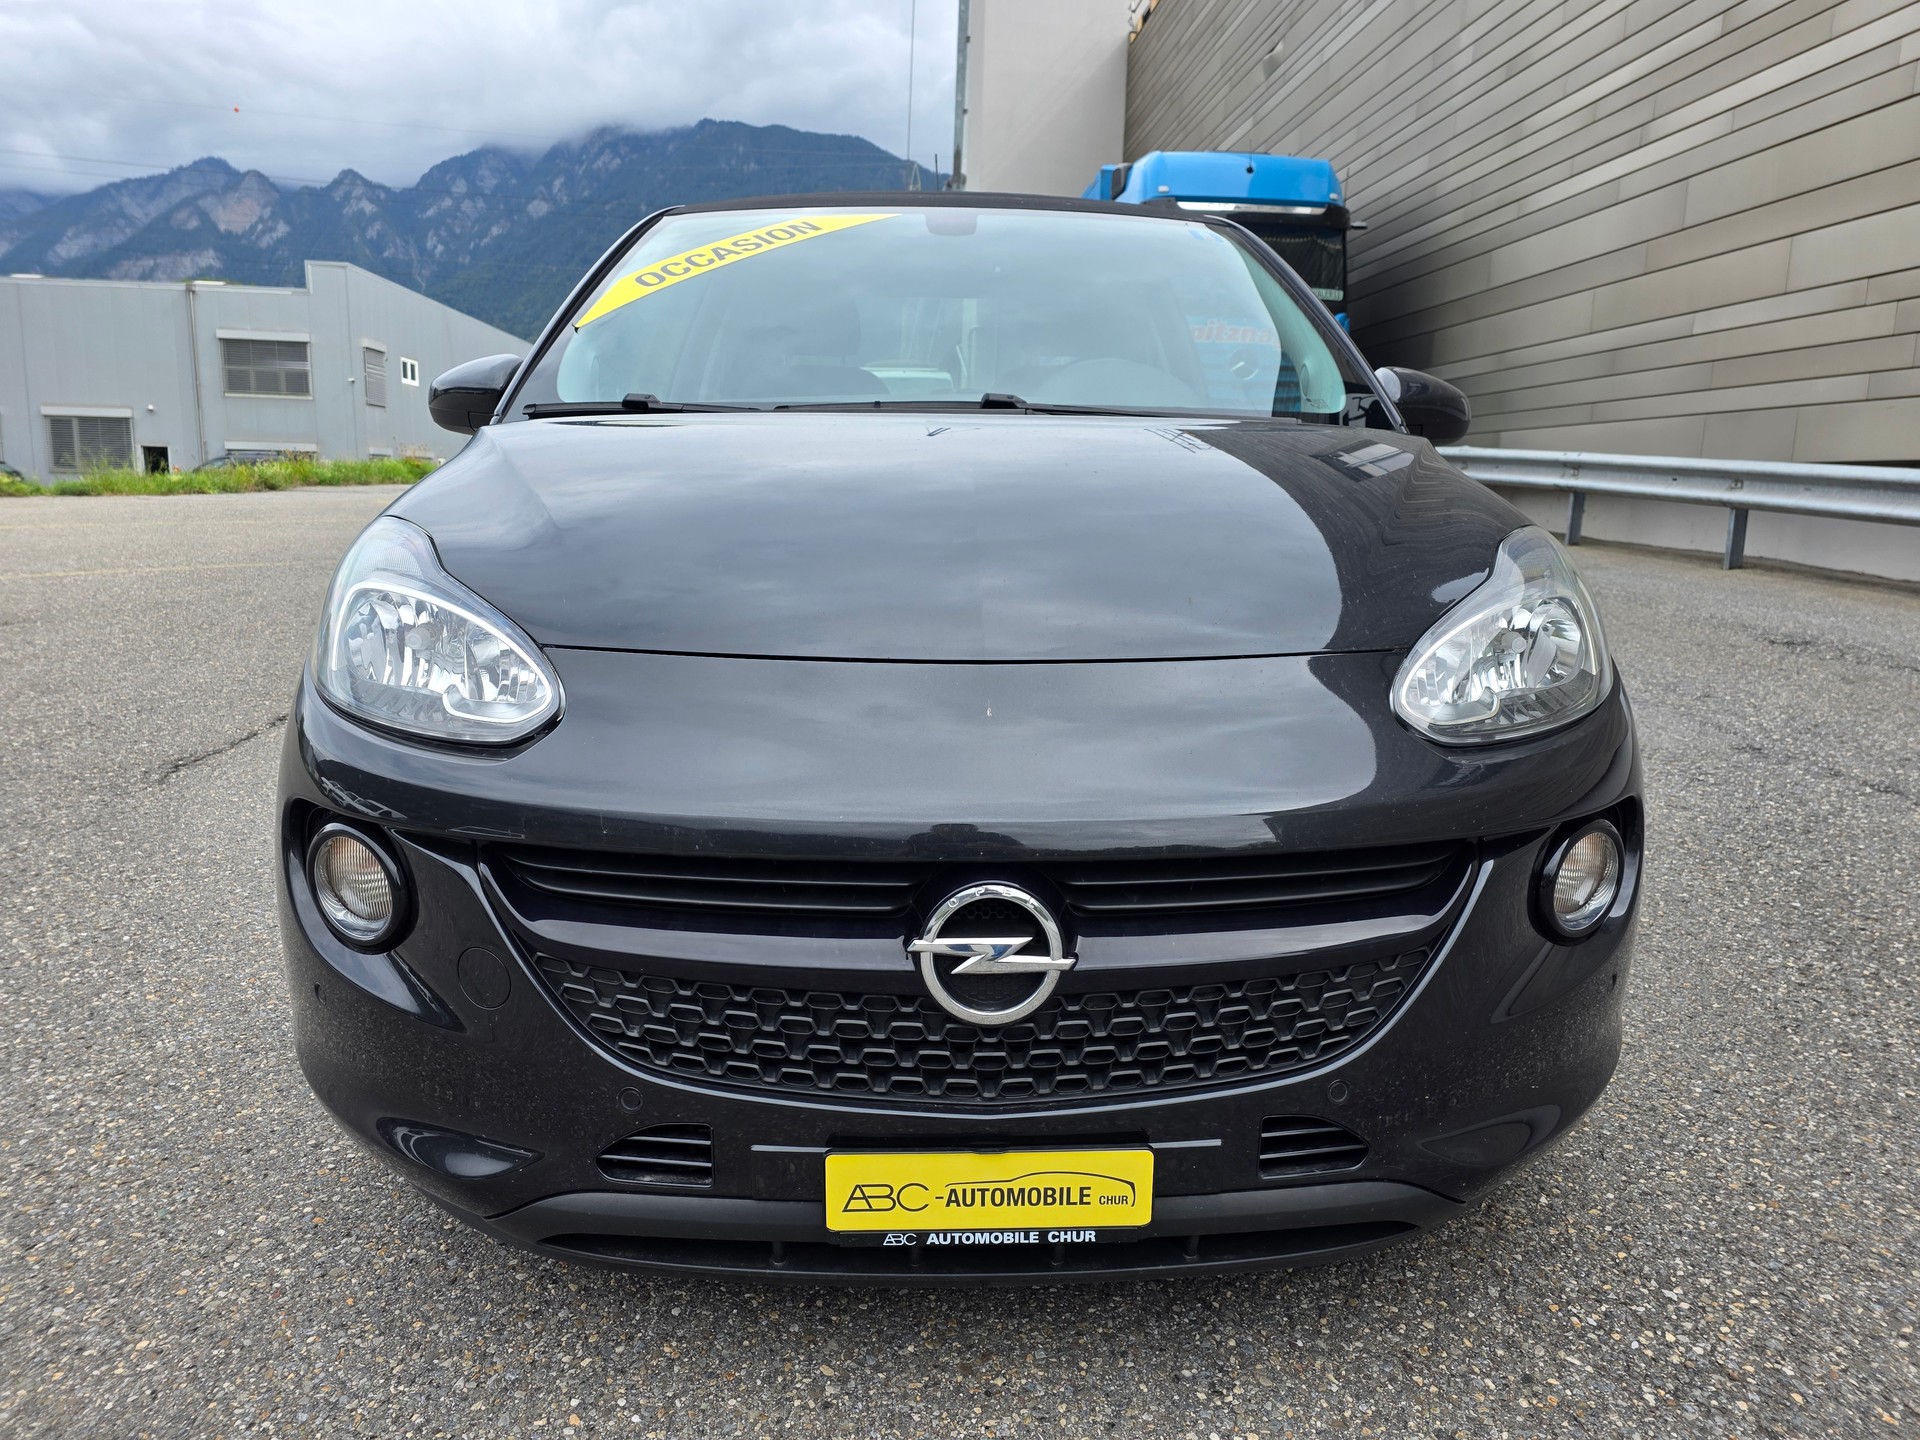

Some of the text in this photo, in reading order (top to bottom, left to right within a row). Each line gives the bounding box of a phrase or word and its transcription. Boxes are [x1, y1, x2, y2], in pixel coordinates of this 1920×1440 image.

[635, 221, 822, 287] OCCASION
[1099, 1193, 1129, 1205] CHUR
[883, 1230, 1096, 1246] ABC AUTOMOBILE CHUR
